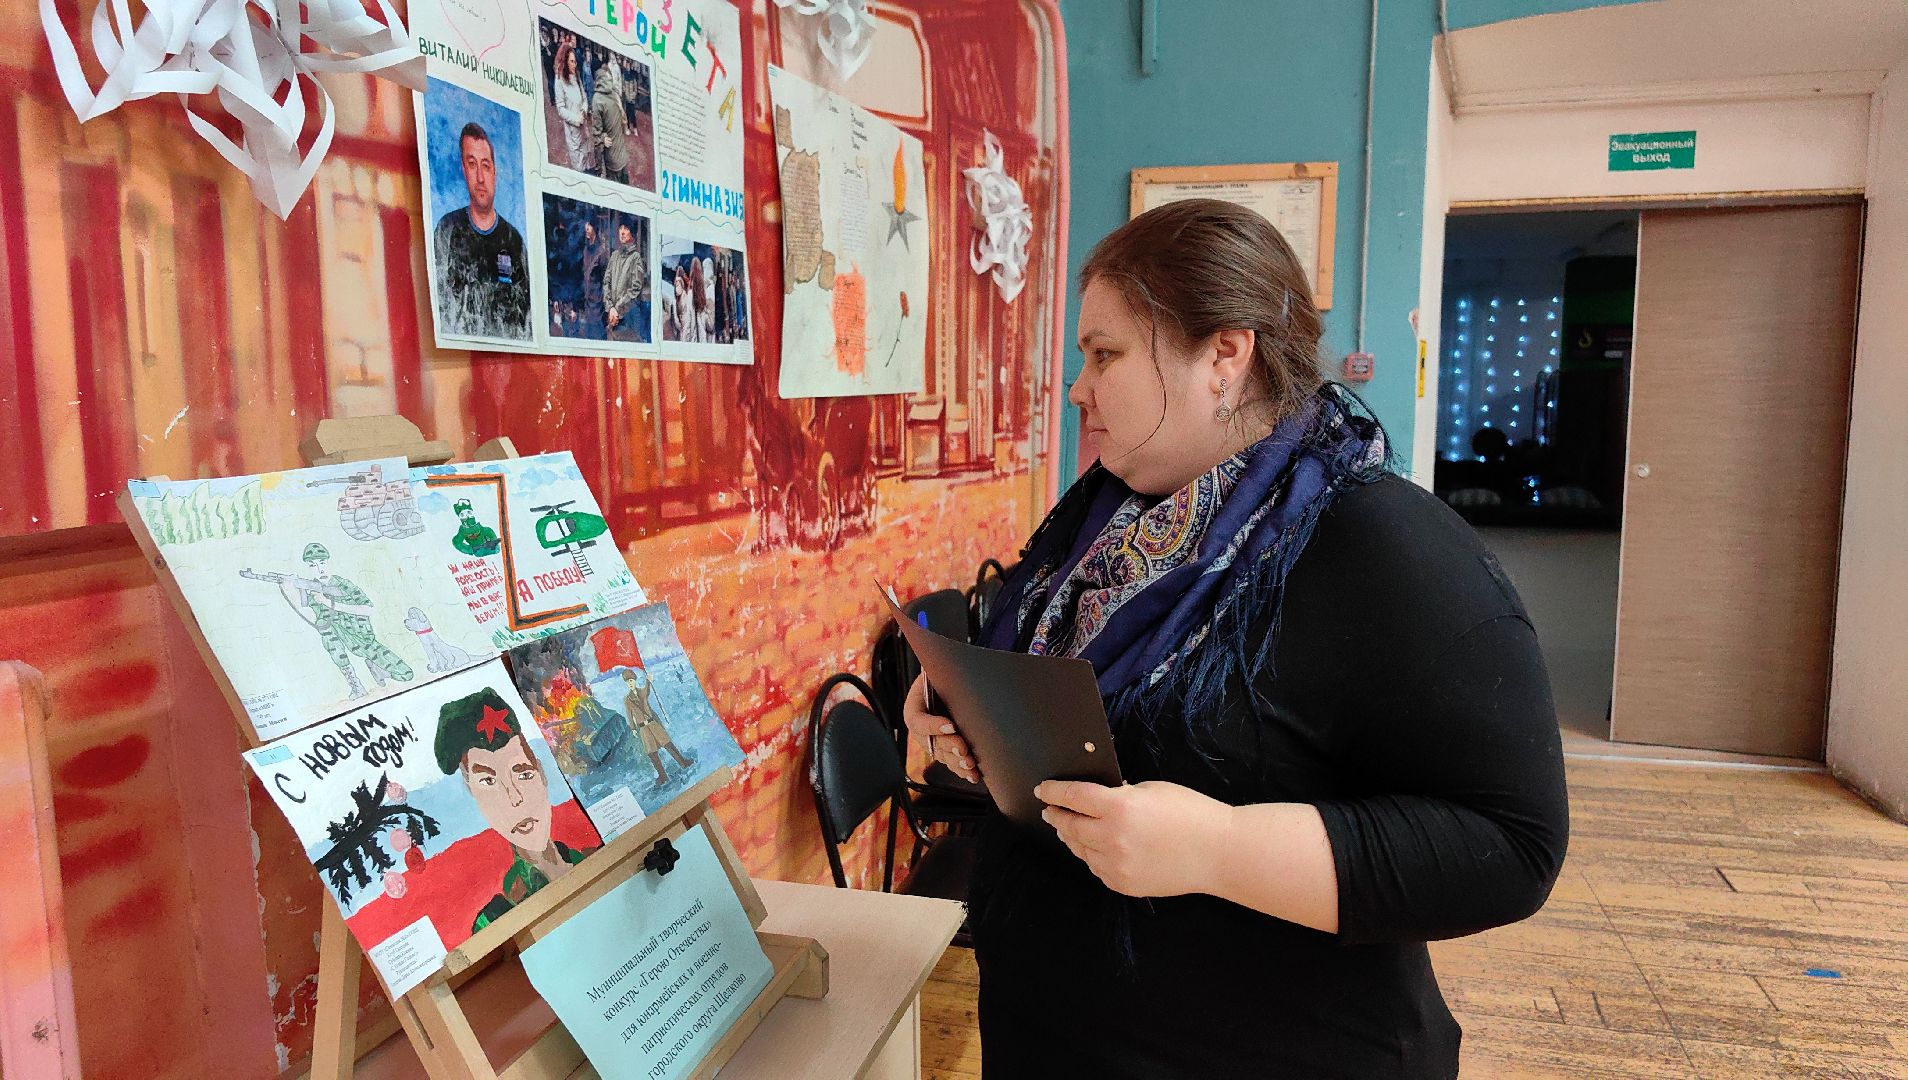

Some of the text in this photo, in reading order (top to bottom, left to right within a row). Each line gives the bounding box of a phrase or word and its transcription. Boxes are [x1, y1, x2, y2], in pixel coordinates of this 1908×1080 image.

[419, 37, 535, 99] ВИТАЛИЙ НИКОЛАЕВИЧ
[1611, 138, 1695, 152] Эвакуационный
[299, 713, 388, 780] НОВЫМ
[586, 897, 705, 1004] Муниципальный творческий
[602, 920, 712, 1022] конкурс «Герою Отечества»
[621, 1022, 639, 1044] для
[637, 972, 690, 1026] юнармейских
[694, 941, 722, 970] военно-
[640, 962, 729, 1055] патриотических отрядов
[648, 973, 747, 1080] городского округа Щелково
